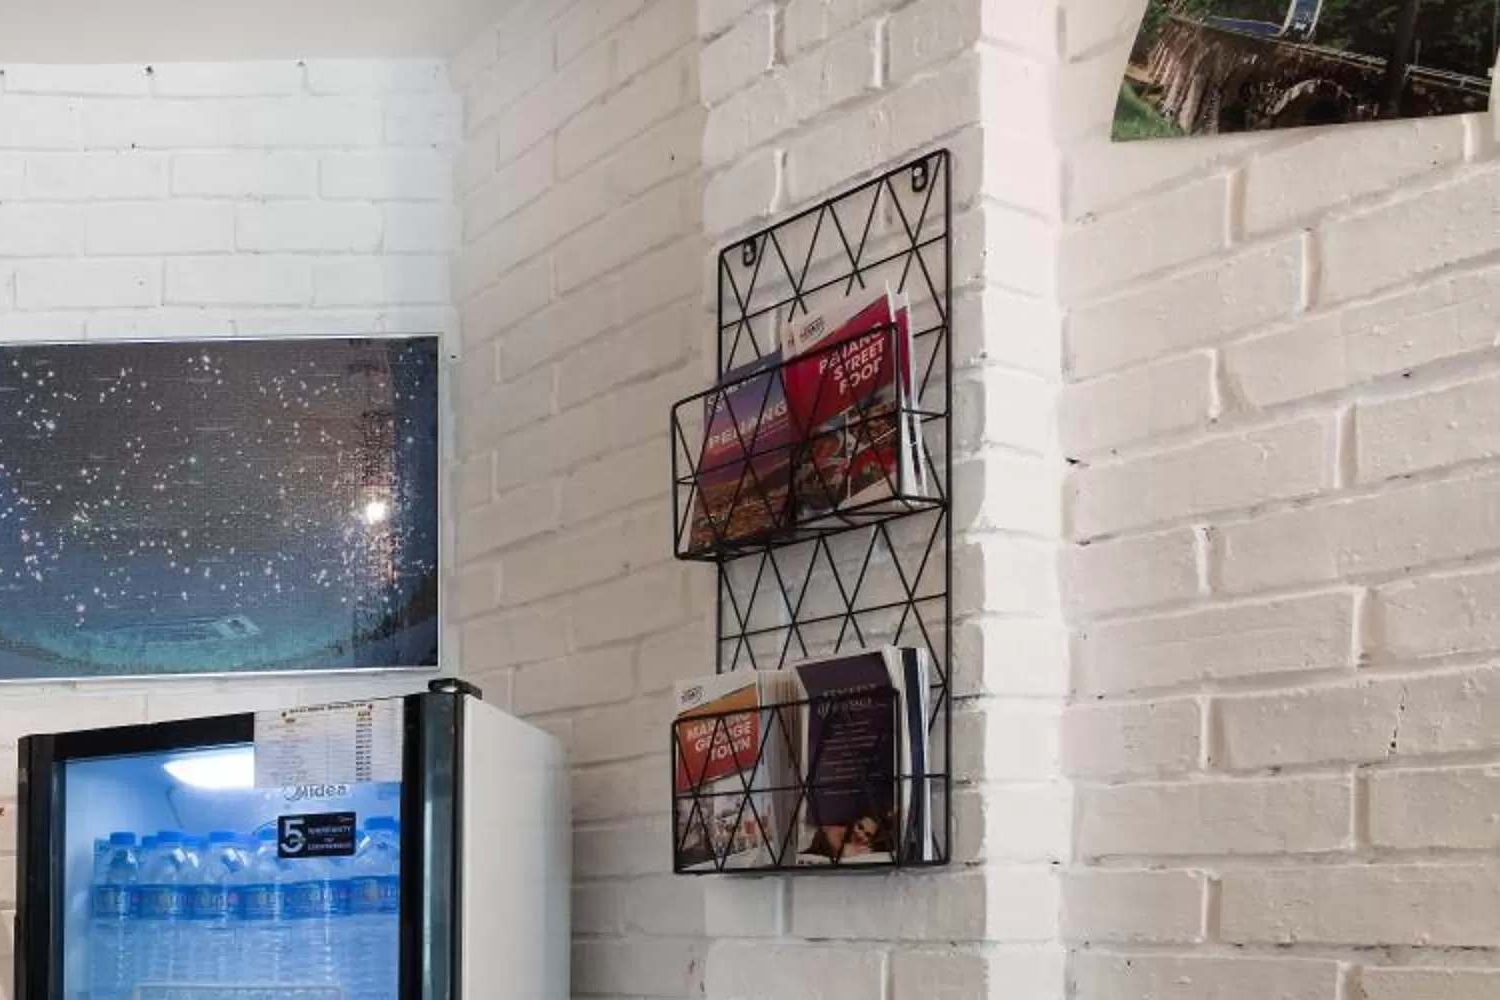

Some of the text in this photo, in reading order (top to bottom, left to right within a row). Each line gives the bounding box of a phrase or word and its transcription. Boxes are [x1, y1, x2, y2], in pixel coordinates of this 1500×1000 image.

[833, 337, 885, 381] STREET
[282, 783, 347, 801] Midea
[280, 818, 305, 854] 5
